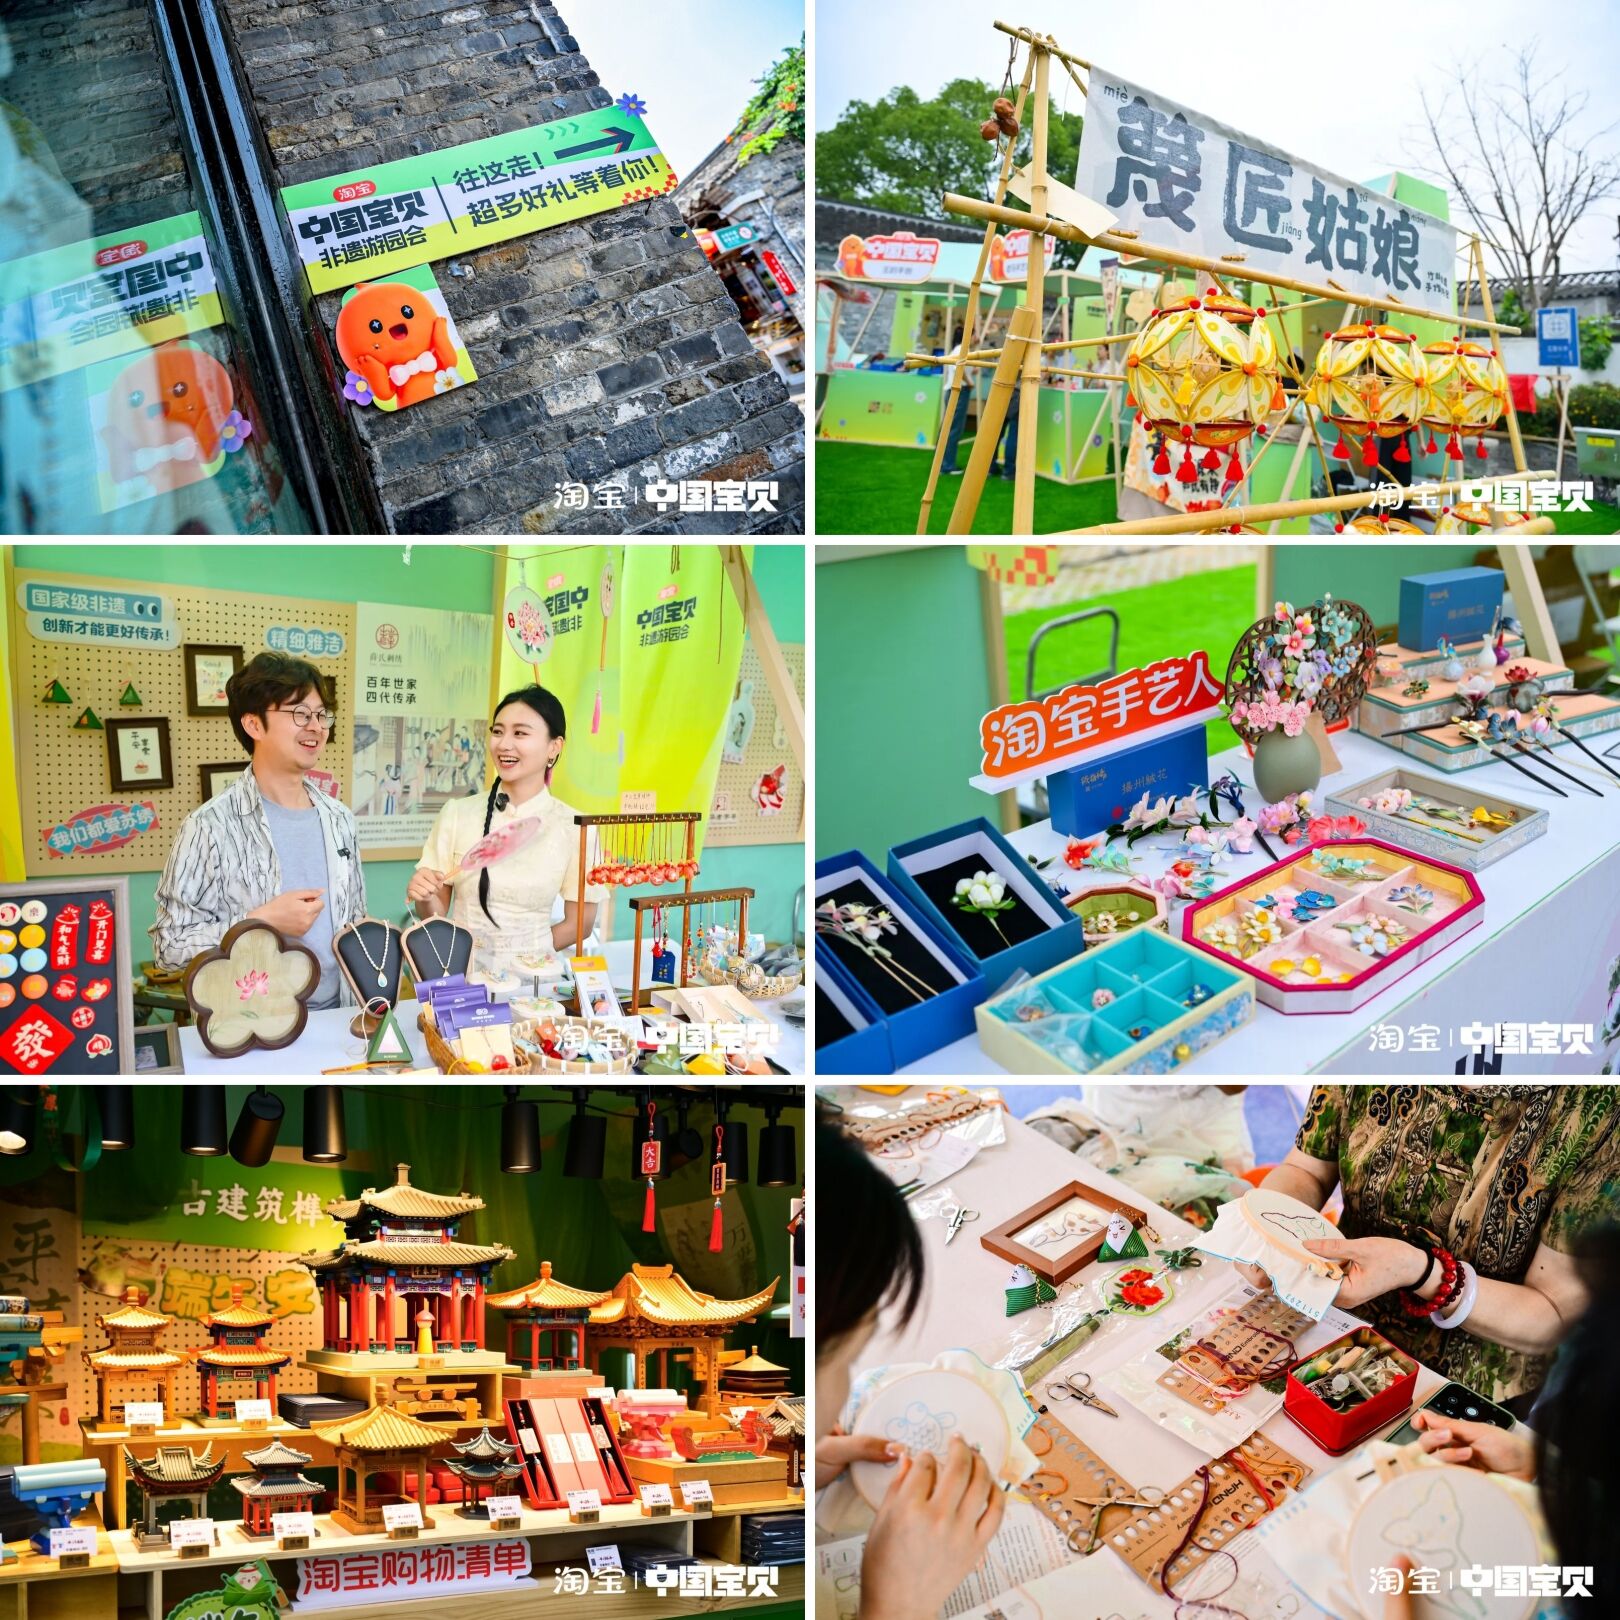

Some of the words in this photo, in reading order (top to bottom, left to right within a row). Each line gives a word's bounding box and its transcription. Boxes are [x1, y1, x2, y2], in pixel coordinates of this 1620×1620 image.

[453, 151, 545, 193] 往这走!
[338, 183, 373, 198] 淘宝
[466, 155, 660, 227] 超多好礼等着你!
[299, 190, 429, 245] 中国宝贝
[320, 224, 428, 270] 非遗游园会
[31, 588, 126, 615] 国家级非遗
[637, 597, 697, 630] 中国宝贝
[42, 617, 169, 641] 创新才能更好传承!
[270, 629, 341, 653] 精细雅洁
[639, 624, 690, 647] 非遗游园会
[366, 676, 417, 690] 百年世家
[366, 691, 417, 704] 四代传承
[991, 658, 1221, 768] 淘宝手艺人
[302, 1541, 527, 1595] 淘宝购物清单
